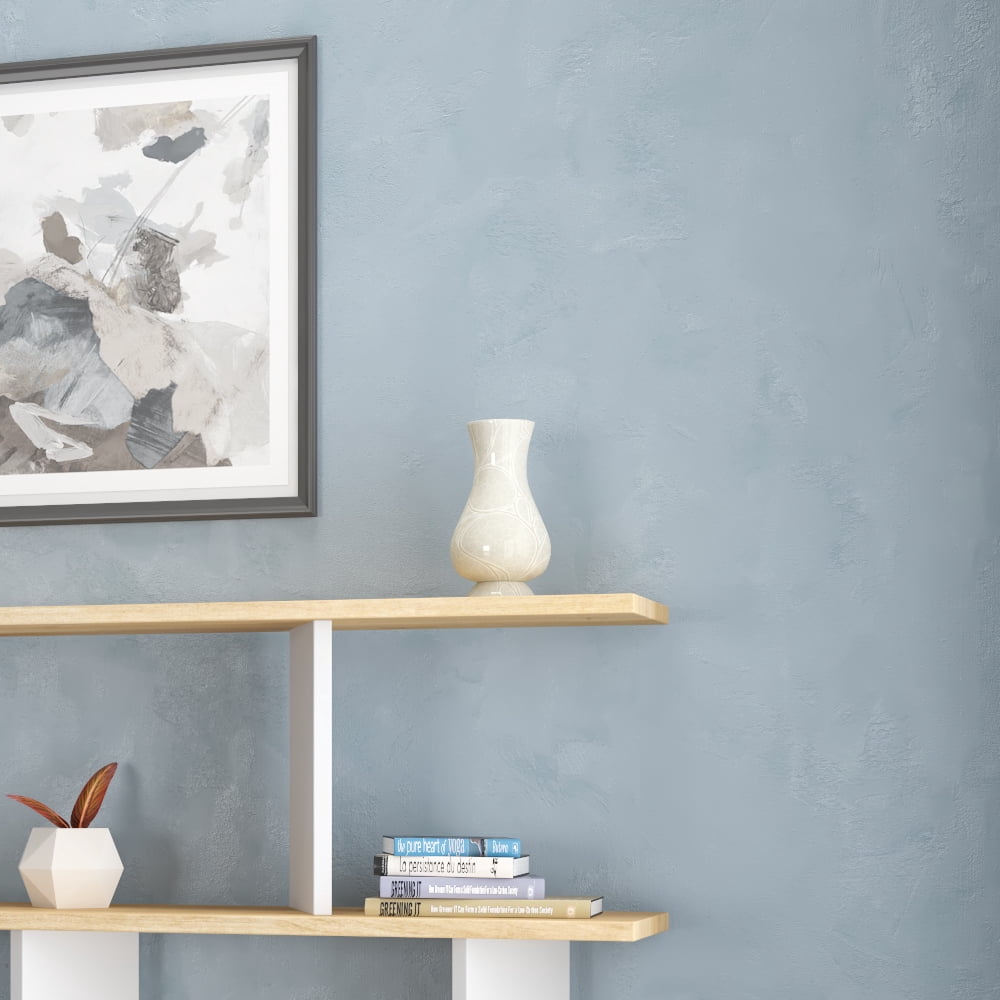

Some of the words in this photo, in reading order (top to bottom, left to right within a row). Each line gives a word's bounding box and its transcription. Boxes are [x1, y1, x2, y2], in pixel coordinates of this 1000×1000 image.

[406, 839, 421, 855] pure
[423, 838, 441, 853] heart
[391, 881, 416, 898] GREENING
[379, 902, 414, 917] GREENING
[414, 902, 422, 917] IT
